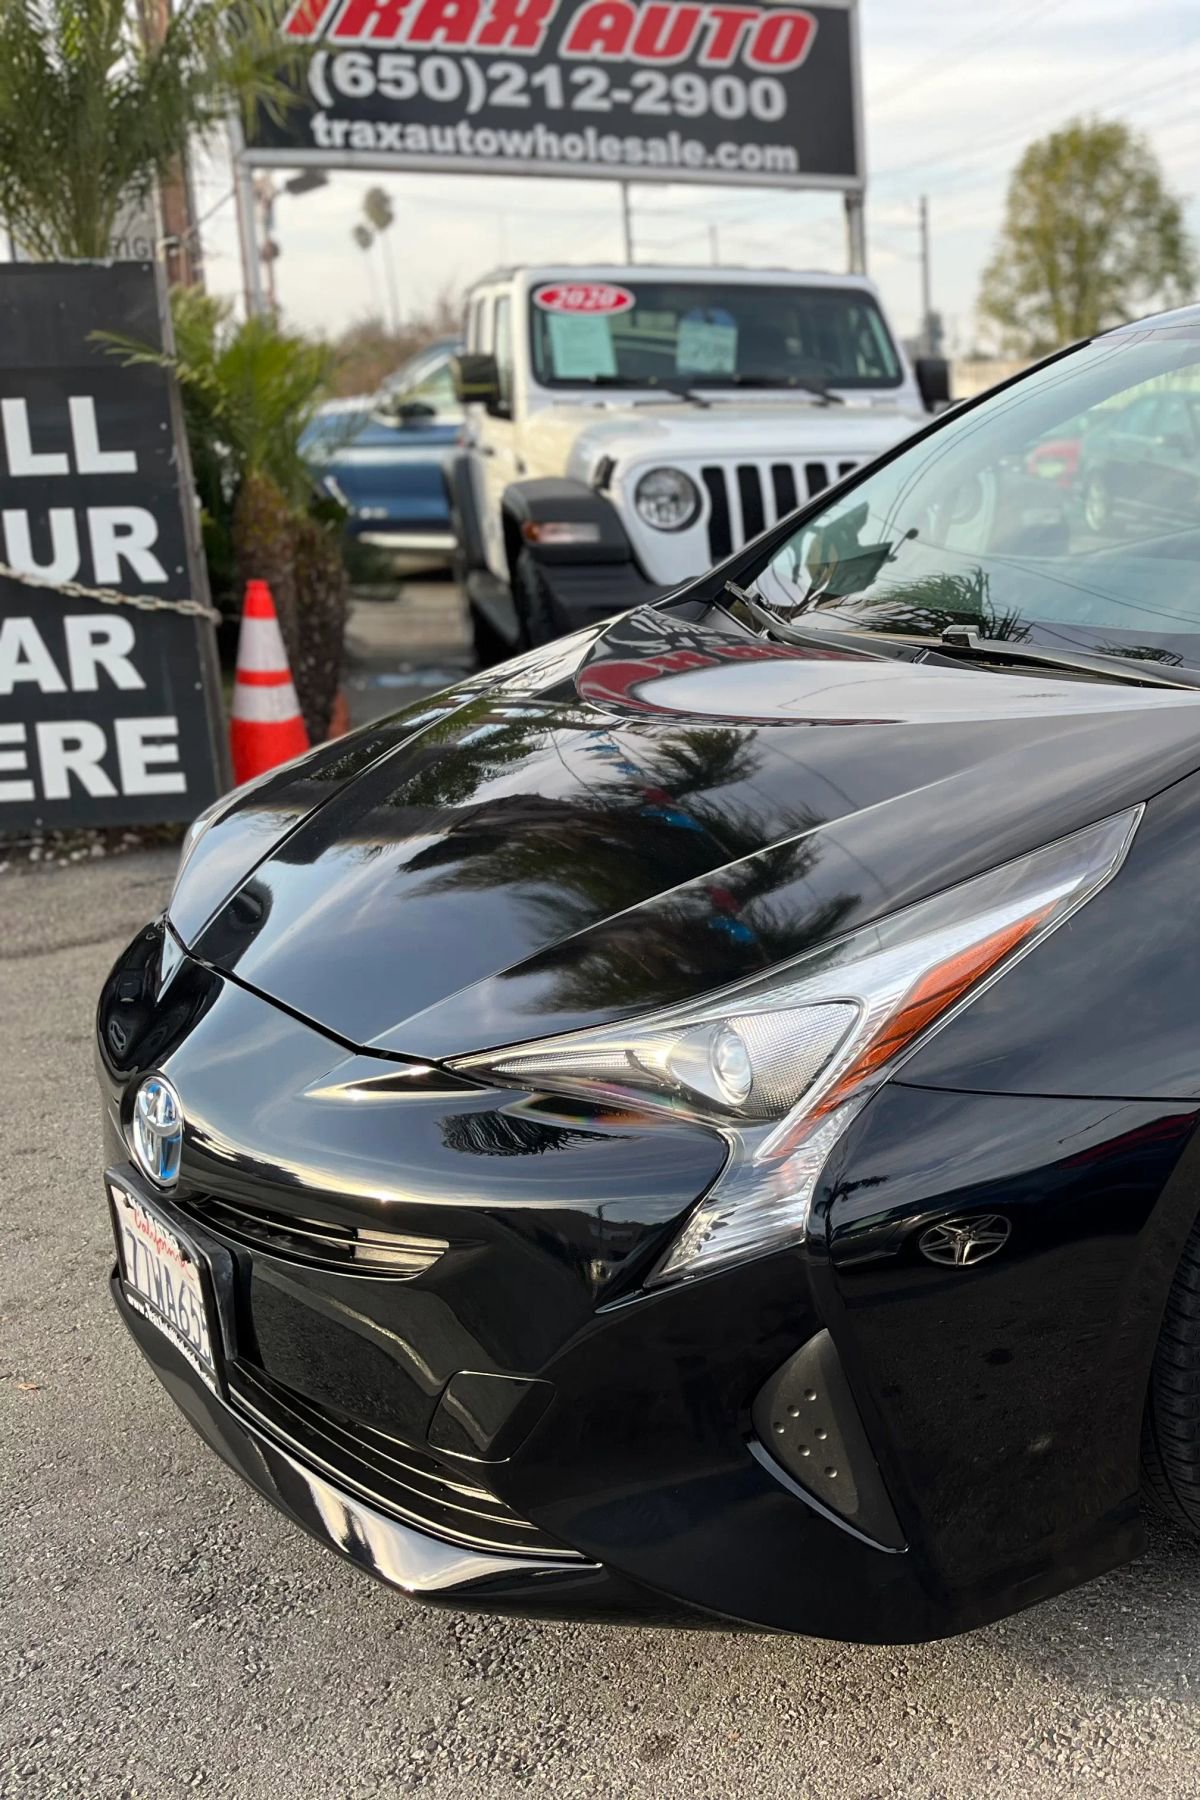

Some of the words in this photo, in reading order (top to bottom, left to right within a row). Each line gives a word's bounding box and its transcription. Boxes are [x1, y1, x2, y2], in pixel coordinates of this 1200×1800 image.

[280, 0, 560, 54] TRAX
[557, 0, 818, 73] AUTO
[308, 52, 788, 121] (650)212-2900
[310, 111, 799, 173] traxautowholesale.com
